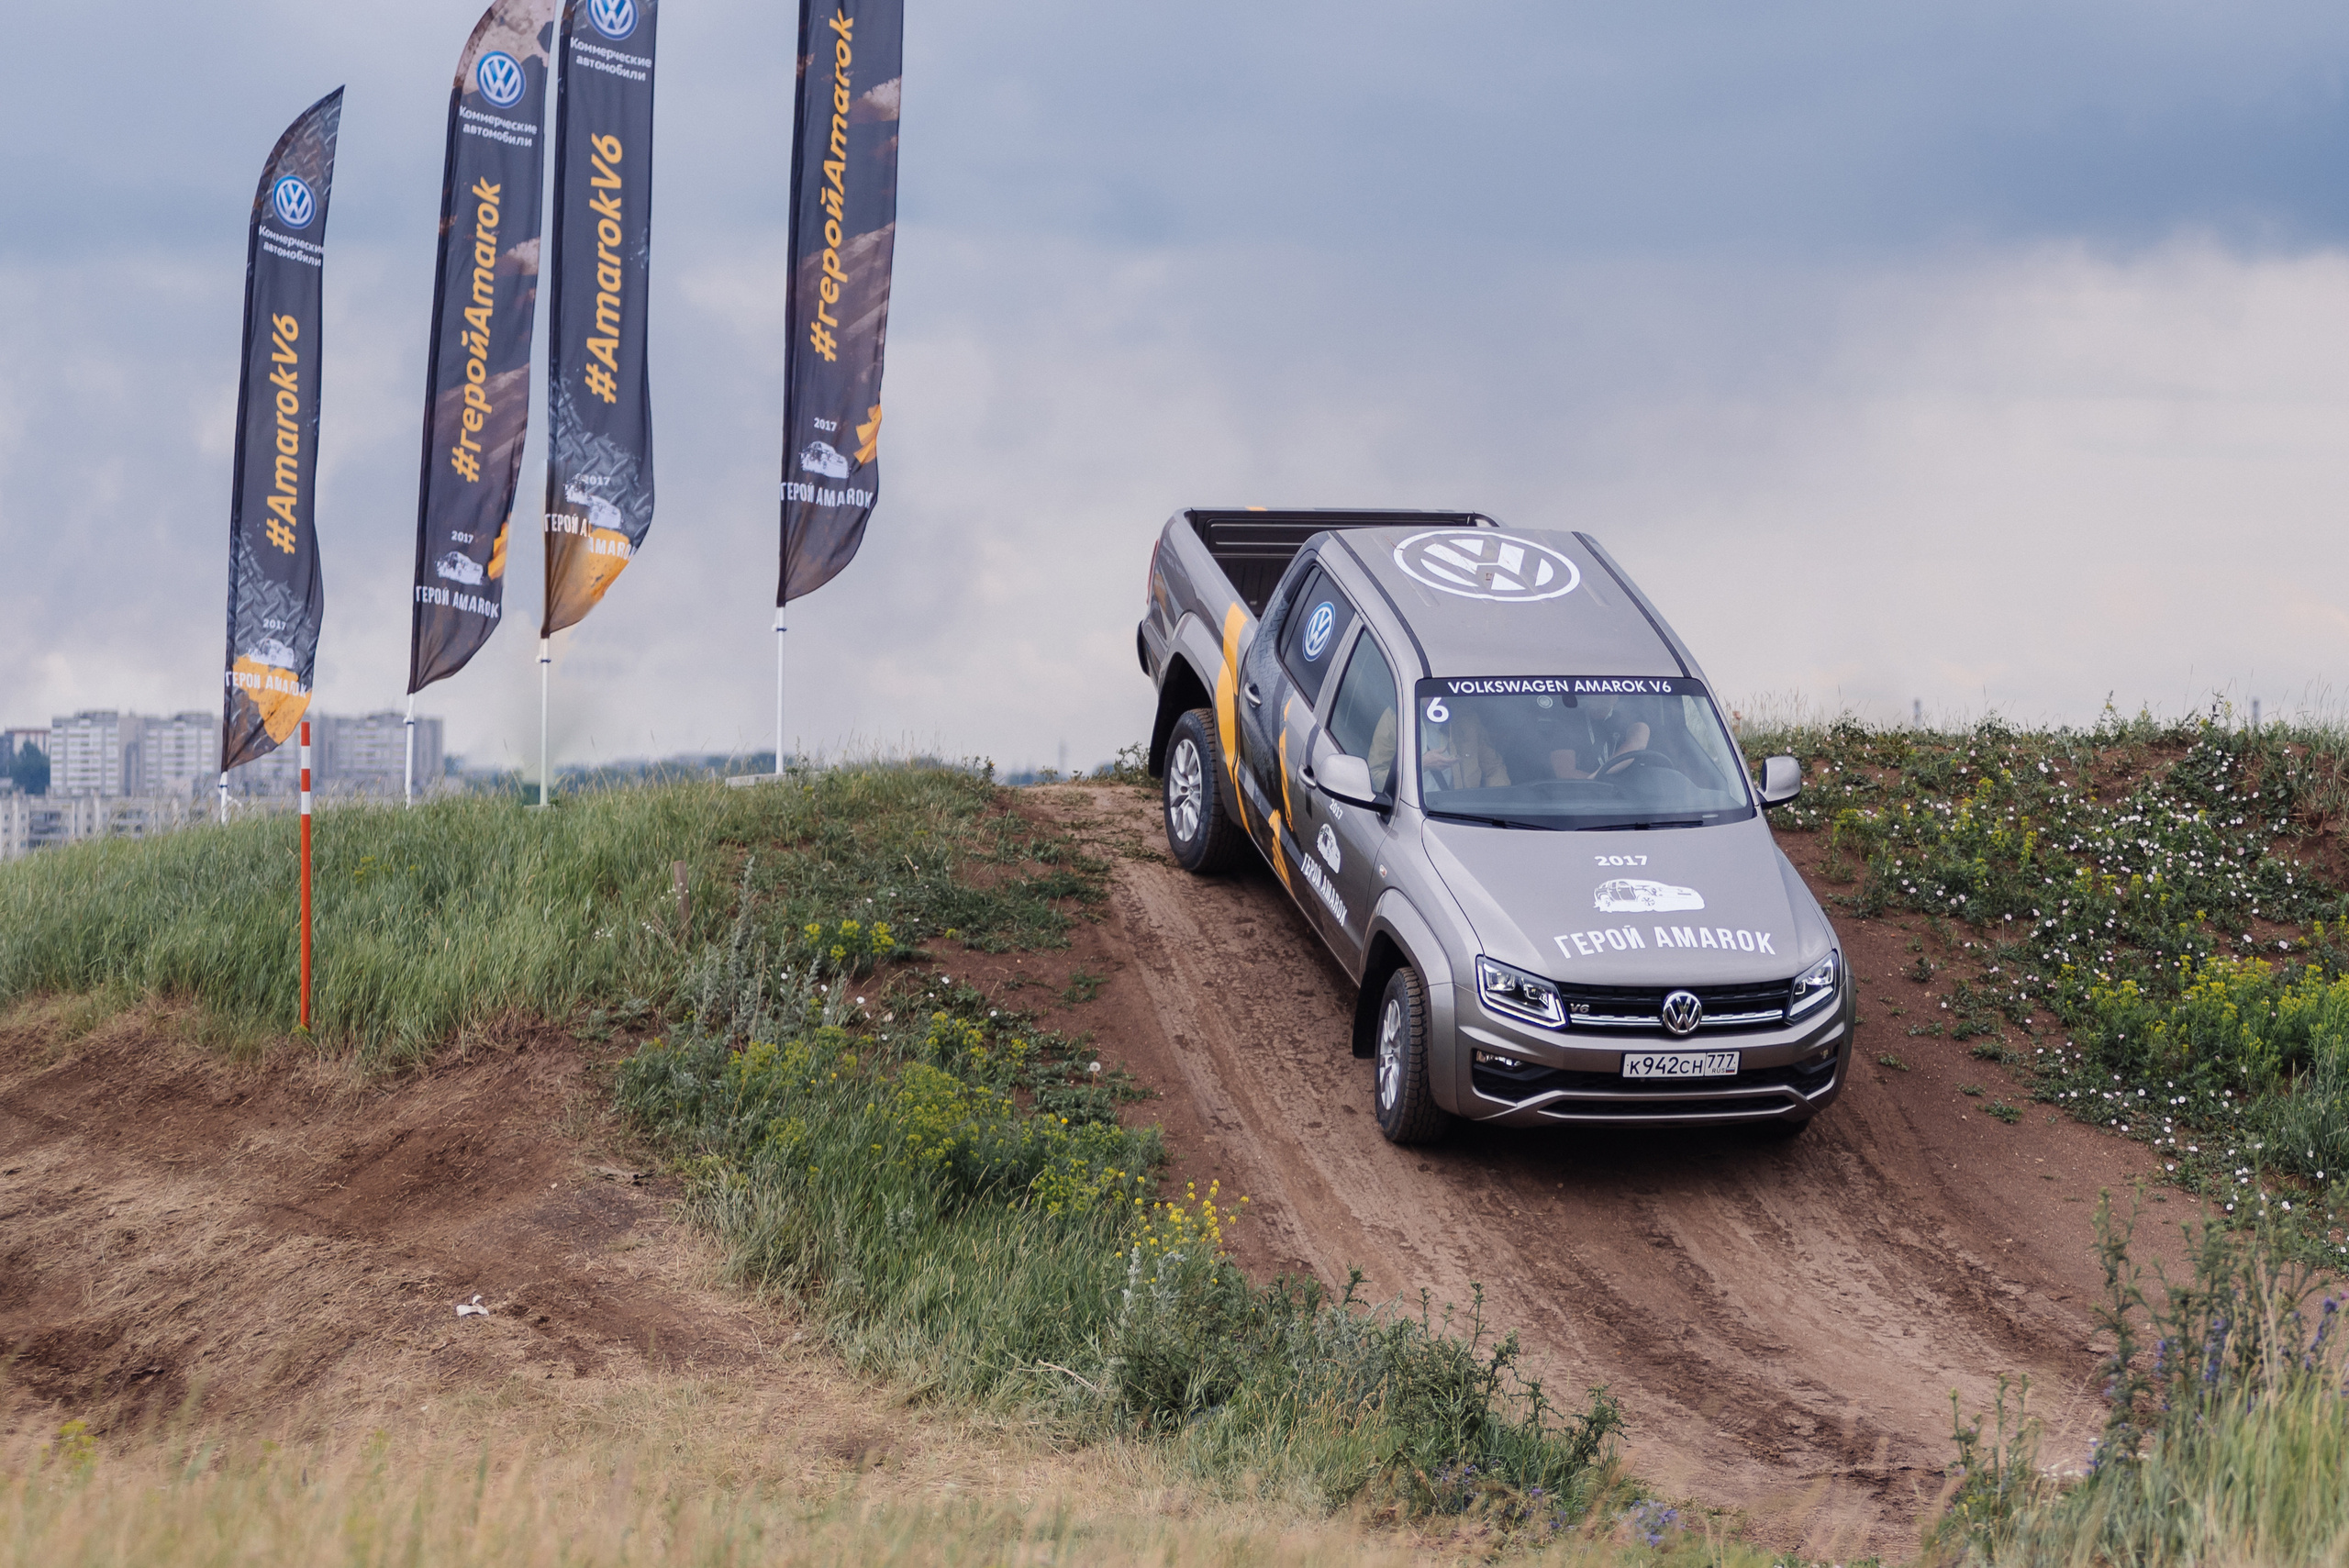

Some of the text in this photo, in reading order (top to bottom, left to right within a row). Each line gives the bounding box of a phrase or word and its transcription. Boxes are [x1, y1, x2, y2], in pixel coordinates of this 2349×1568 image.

[570, 37, 652, 69] Коммерческие
[575, 54, 646, 82] автомобили
[459, 105, 538, 136] Коммерческие
[462, 123, 532, 148] автомобили
[262, 240, 321, 267] автомобили
[584, 132, 622, 404] #AmarokV6
[266, 313, 299, 554] #AmarokV6
[814, 417, 838, 431] 2017
[780, 482, 814, 504] ГЕРОЙ
[451, 529, 474, 544] 2017
[544, 513, 579, 534] ГЕРОЙ
[416, 585, 500, 618] ГЕРОЙ AMAROK
[262, 617, 286, 631] 2017
[1447, 680, 1672, 694] VOLKSWAGEN AMAROK V6
[1426, 696, 1450, 723] 6
[1329, 798, 1343, 820] 2017
[1594, 854, 1648, 866] 2017
[1300, 852, 1348, 927] ГЕРОЙ AMAROK
[1553, 925, 1776, 960] ГЕРОЙ AMAROK
[1569, 1002, 1590, 1014] V6
